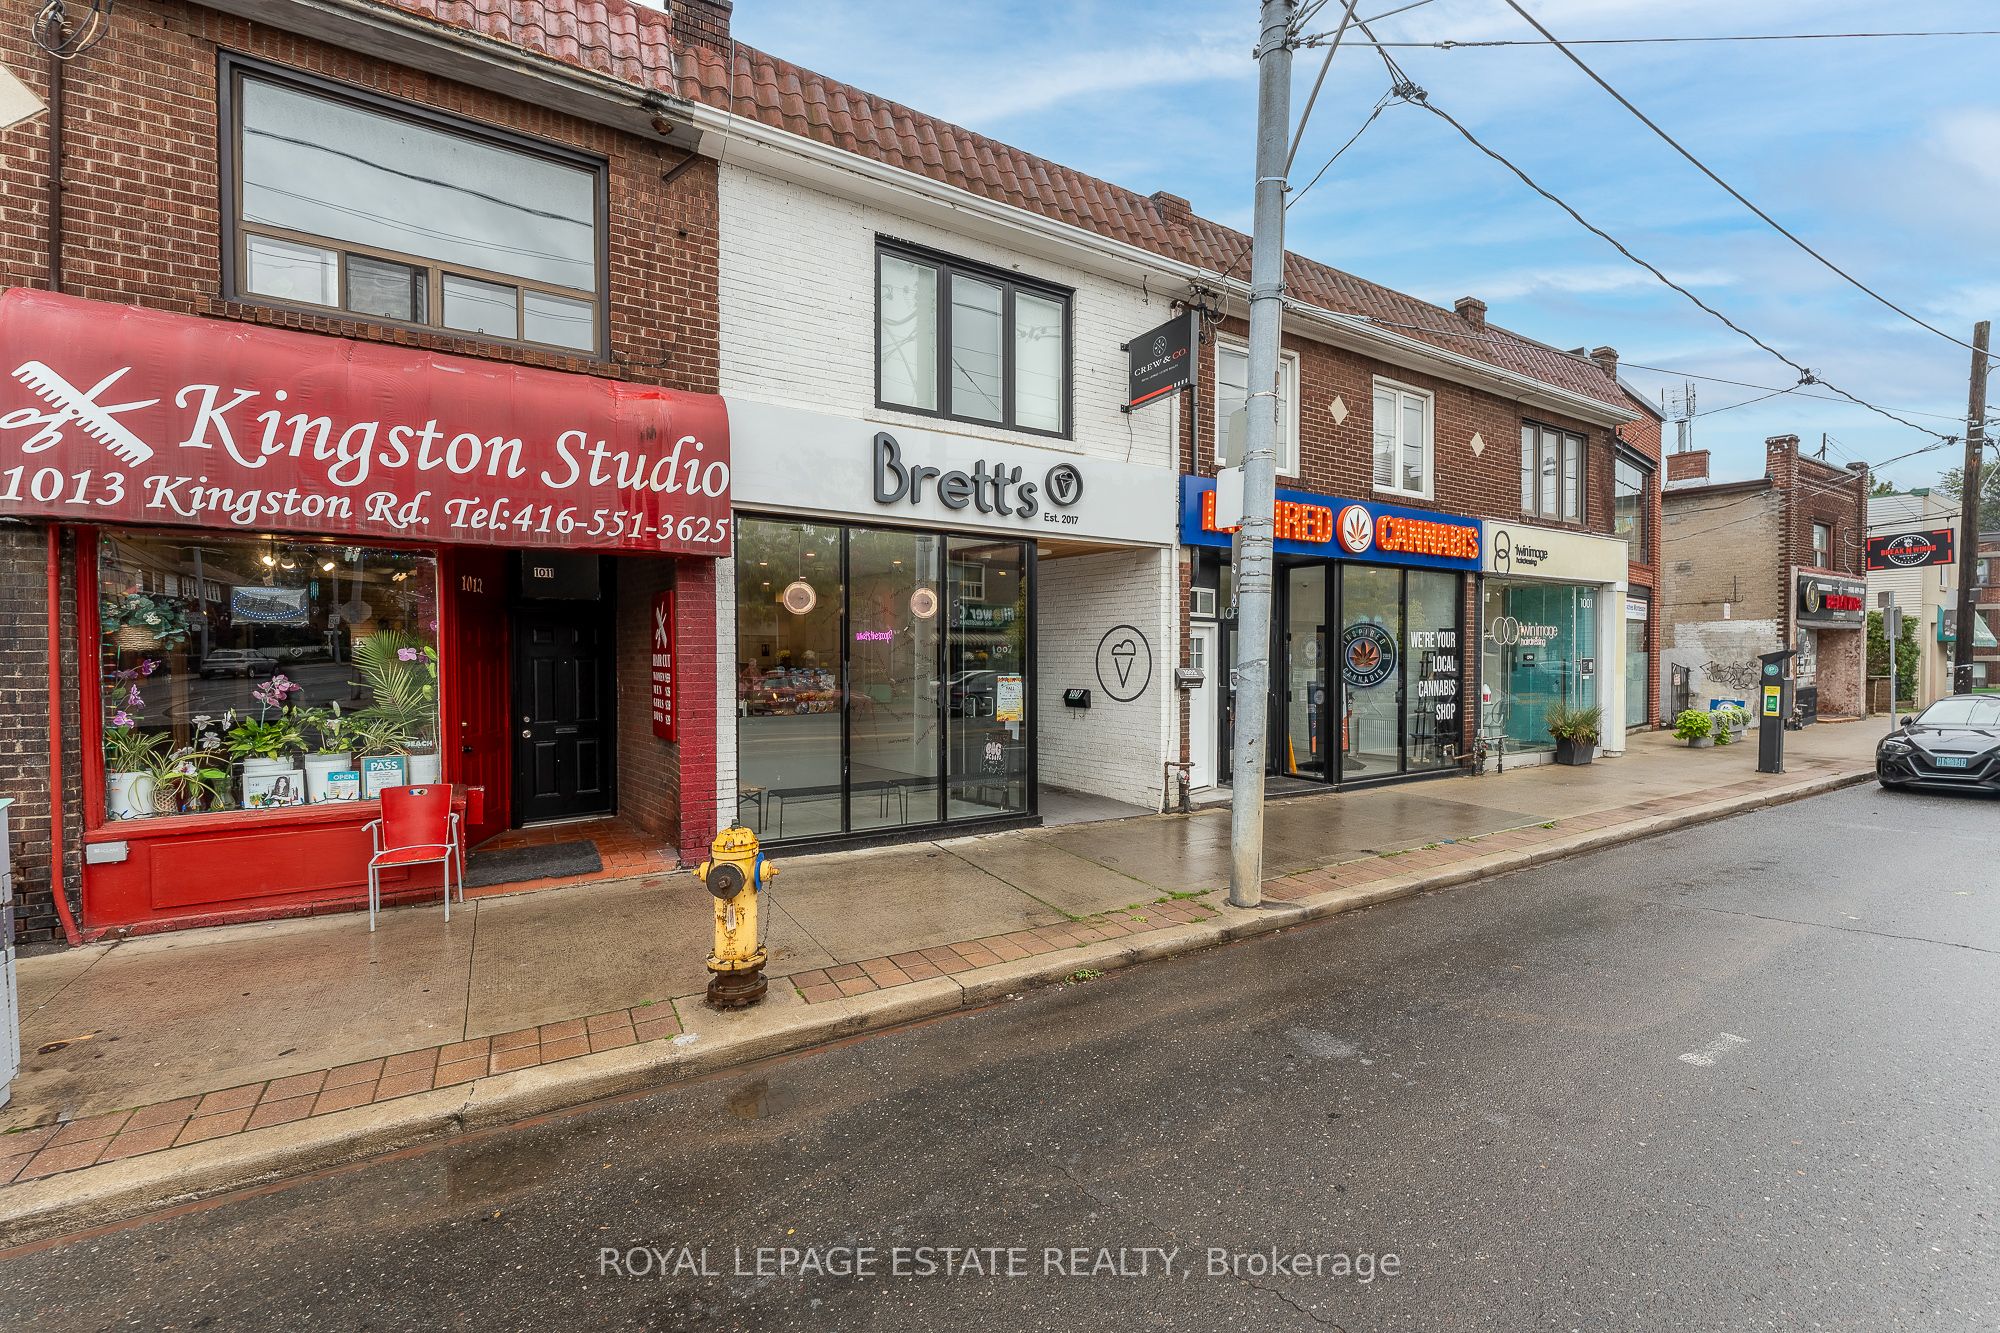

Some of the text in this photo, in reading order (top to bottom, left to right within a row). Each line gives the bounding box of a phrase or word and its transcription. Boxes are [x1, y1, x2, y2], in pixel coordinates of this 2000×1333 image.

[1134, 358, 1162, 377] CREW
[1162, 355, 1171, 364] &
[1172, 348, 1187, 360] CO
[175, 384, 730, 498] Kingston Studio
[873, 431, 1039, 518] Brett's
[0, 465, 125, 506] 1013
[143, 475, 353, 525] Kingston
[365, 491, 430, 529] Rd.
[1044, 513, 1079, 525] Est. 2017
[1376, 515, 1479, 559] CANNABIS
[534, 567, 555, 578] 1011
[1580, 598, 1593, 609] 1001
[1410, 631, 1456, 648] WE'RE YOUR
[1432, 655, 1456, 672] LOCAL
[1342, 667, 1384, 683] CANNABIS
[1418, 679, 1456, 698] CANNABIS
[1436, 703, 1456, 721] SHOP
[370, 762, 398, 771] PASS
